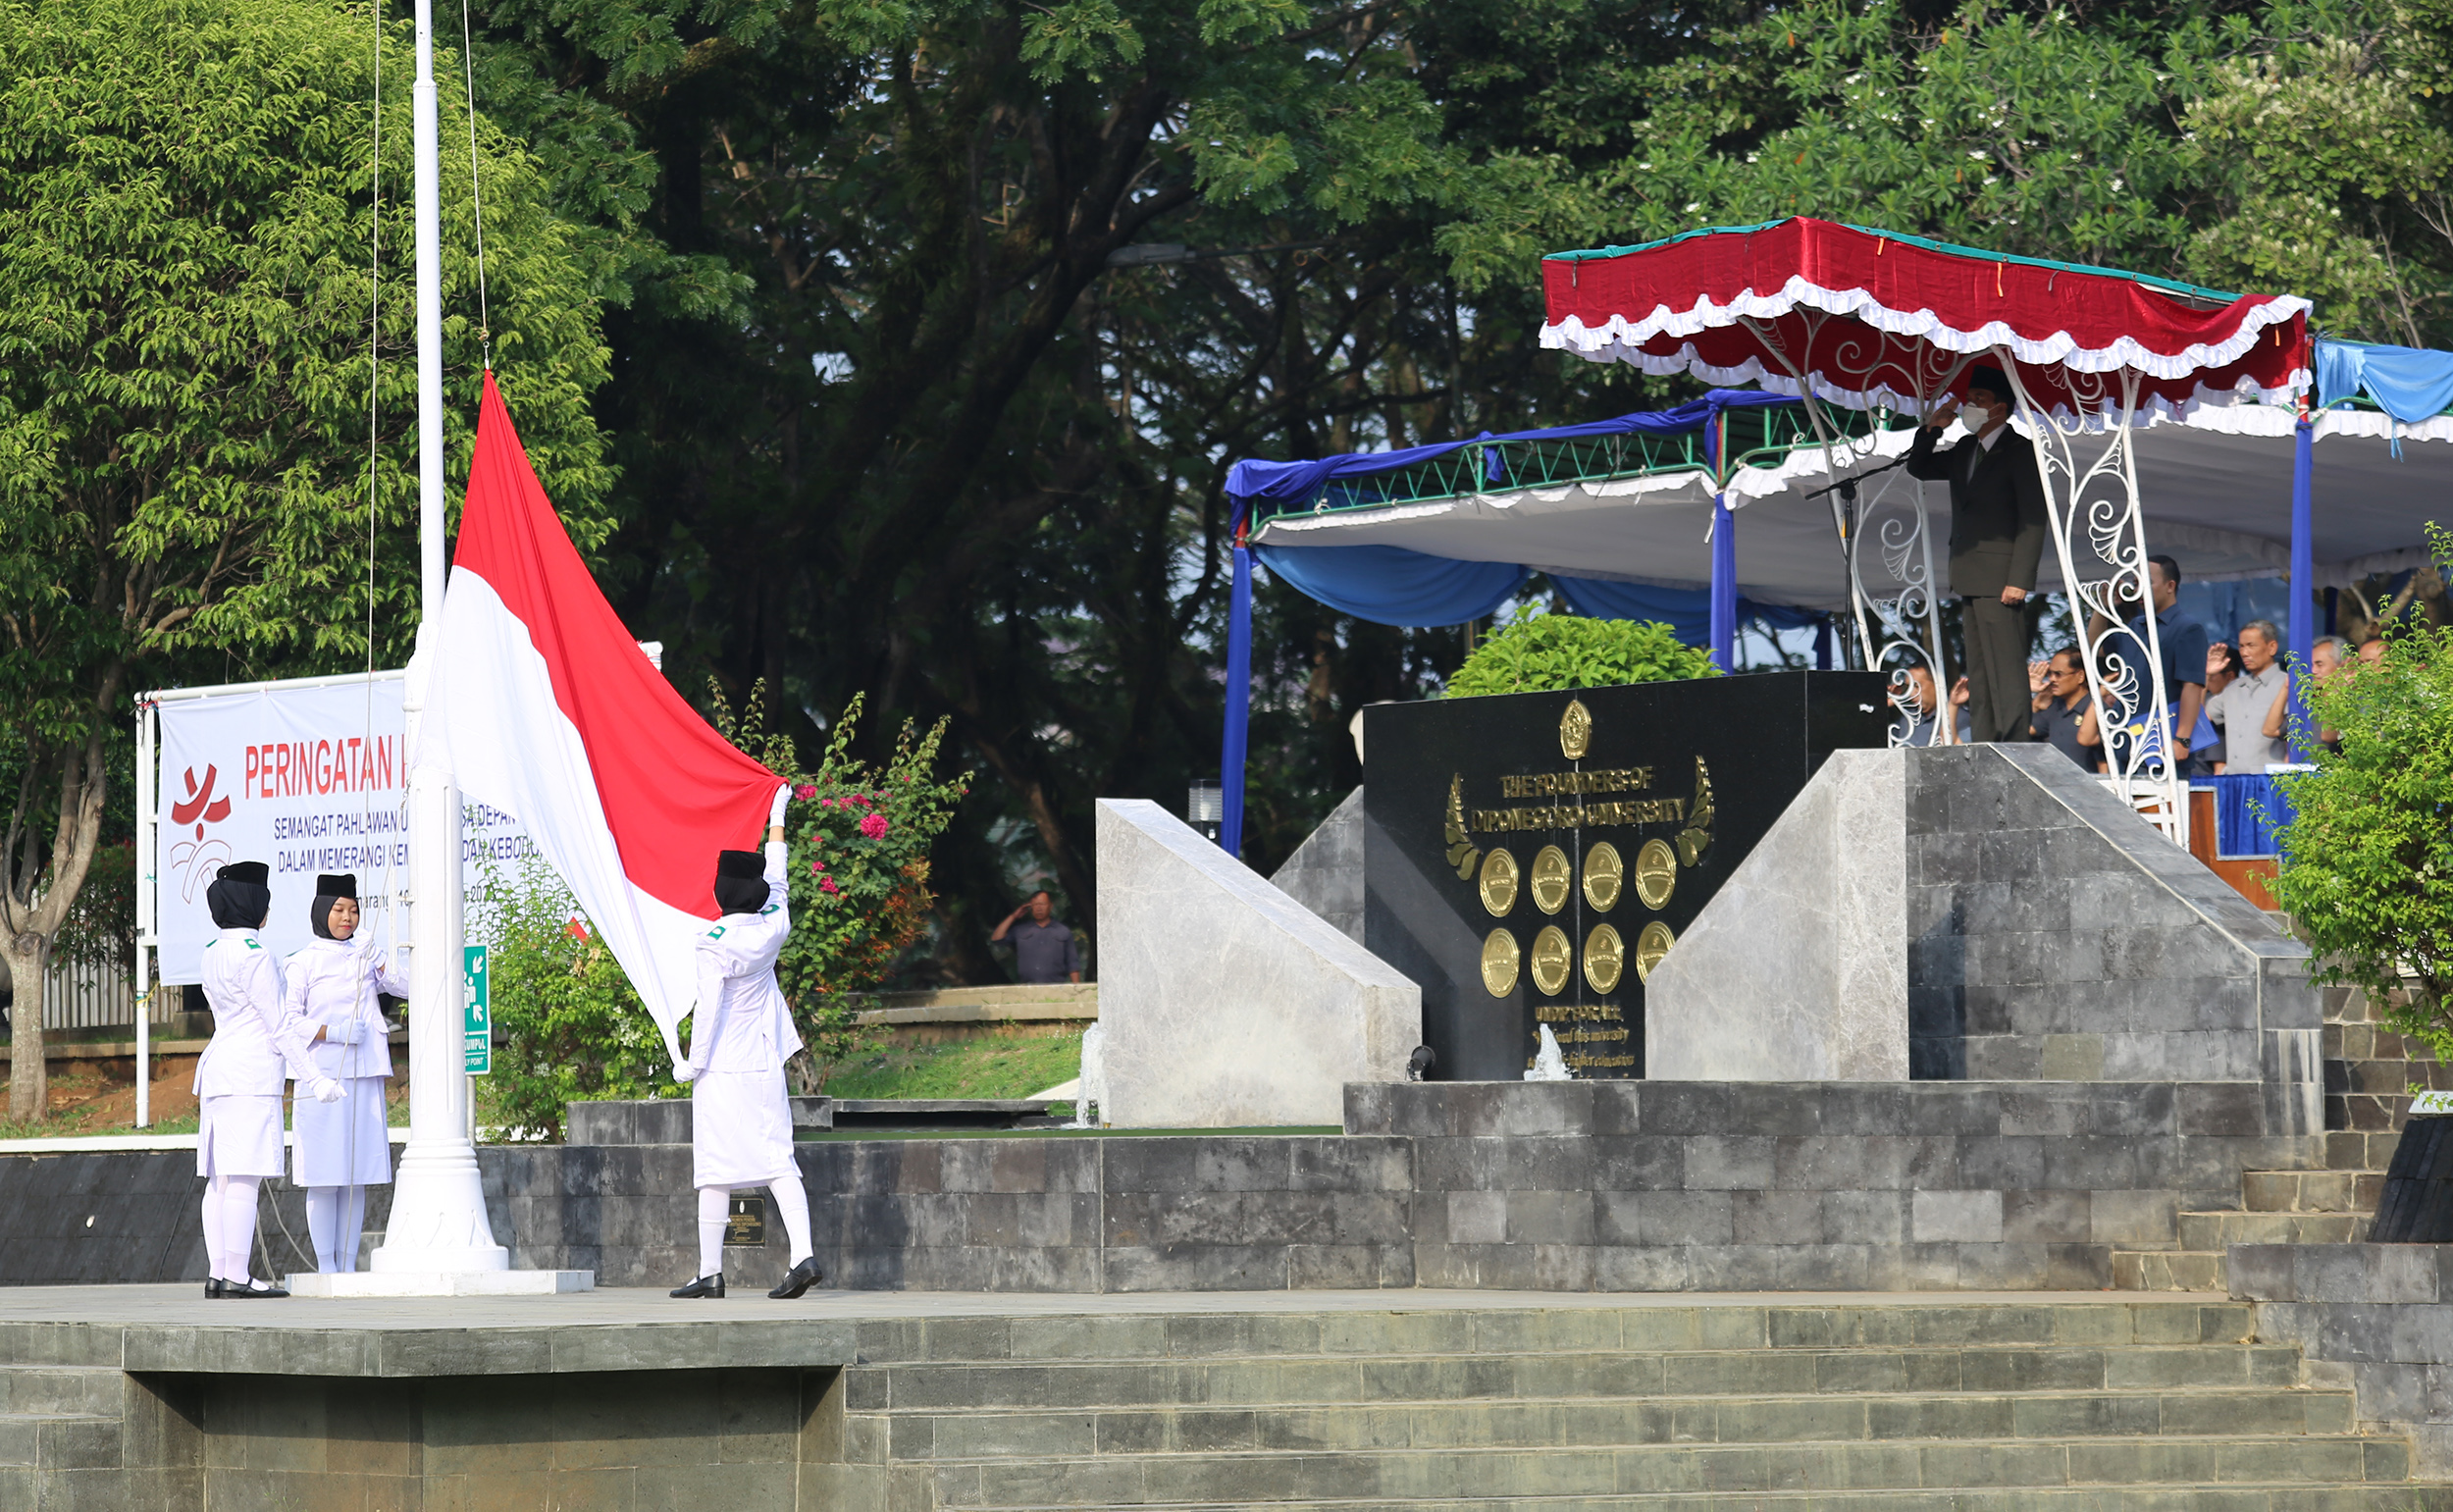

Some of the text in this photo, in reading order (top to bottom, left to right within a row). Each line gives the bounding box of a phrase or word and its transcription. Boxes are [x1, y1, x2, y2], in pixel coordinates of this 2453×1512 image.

[245, 735, 392, 800] PERINGATAN
[1500, 766, 1653, 798] THE FOUNDERS OF
[274, 814, 334, 840] SEMANGAT
[337, 810, 397, 836] PAHLAWAN
[1472, 797, 1686, 833] DIPONEGORO UNIVERSITY
[278, 850, 315, 873] DALAM
[319, 845, 386, 870] MEMERANGI
